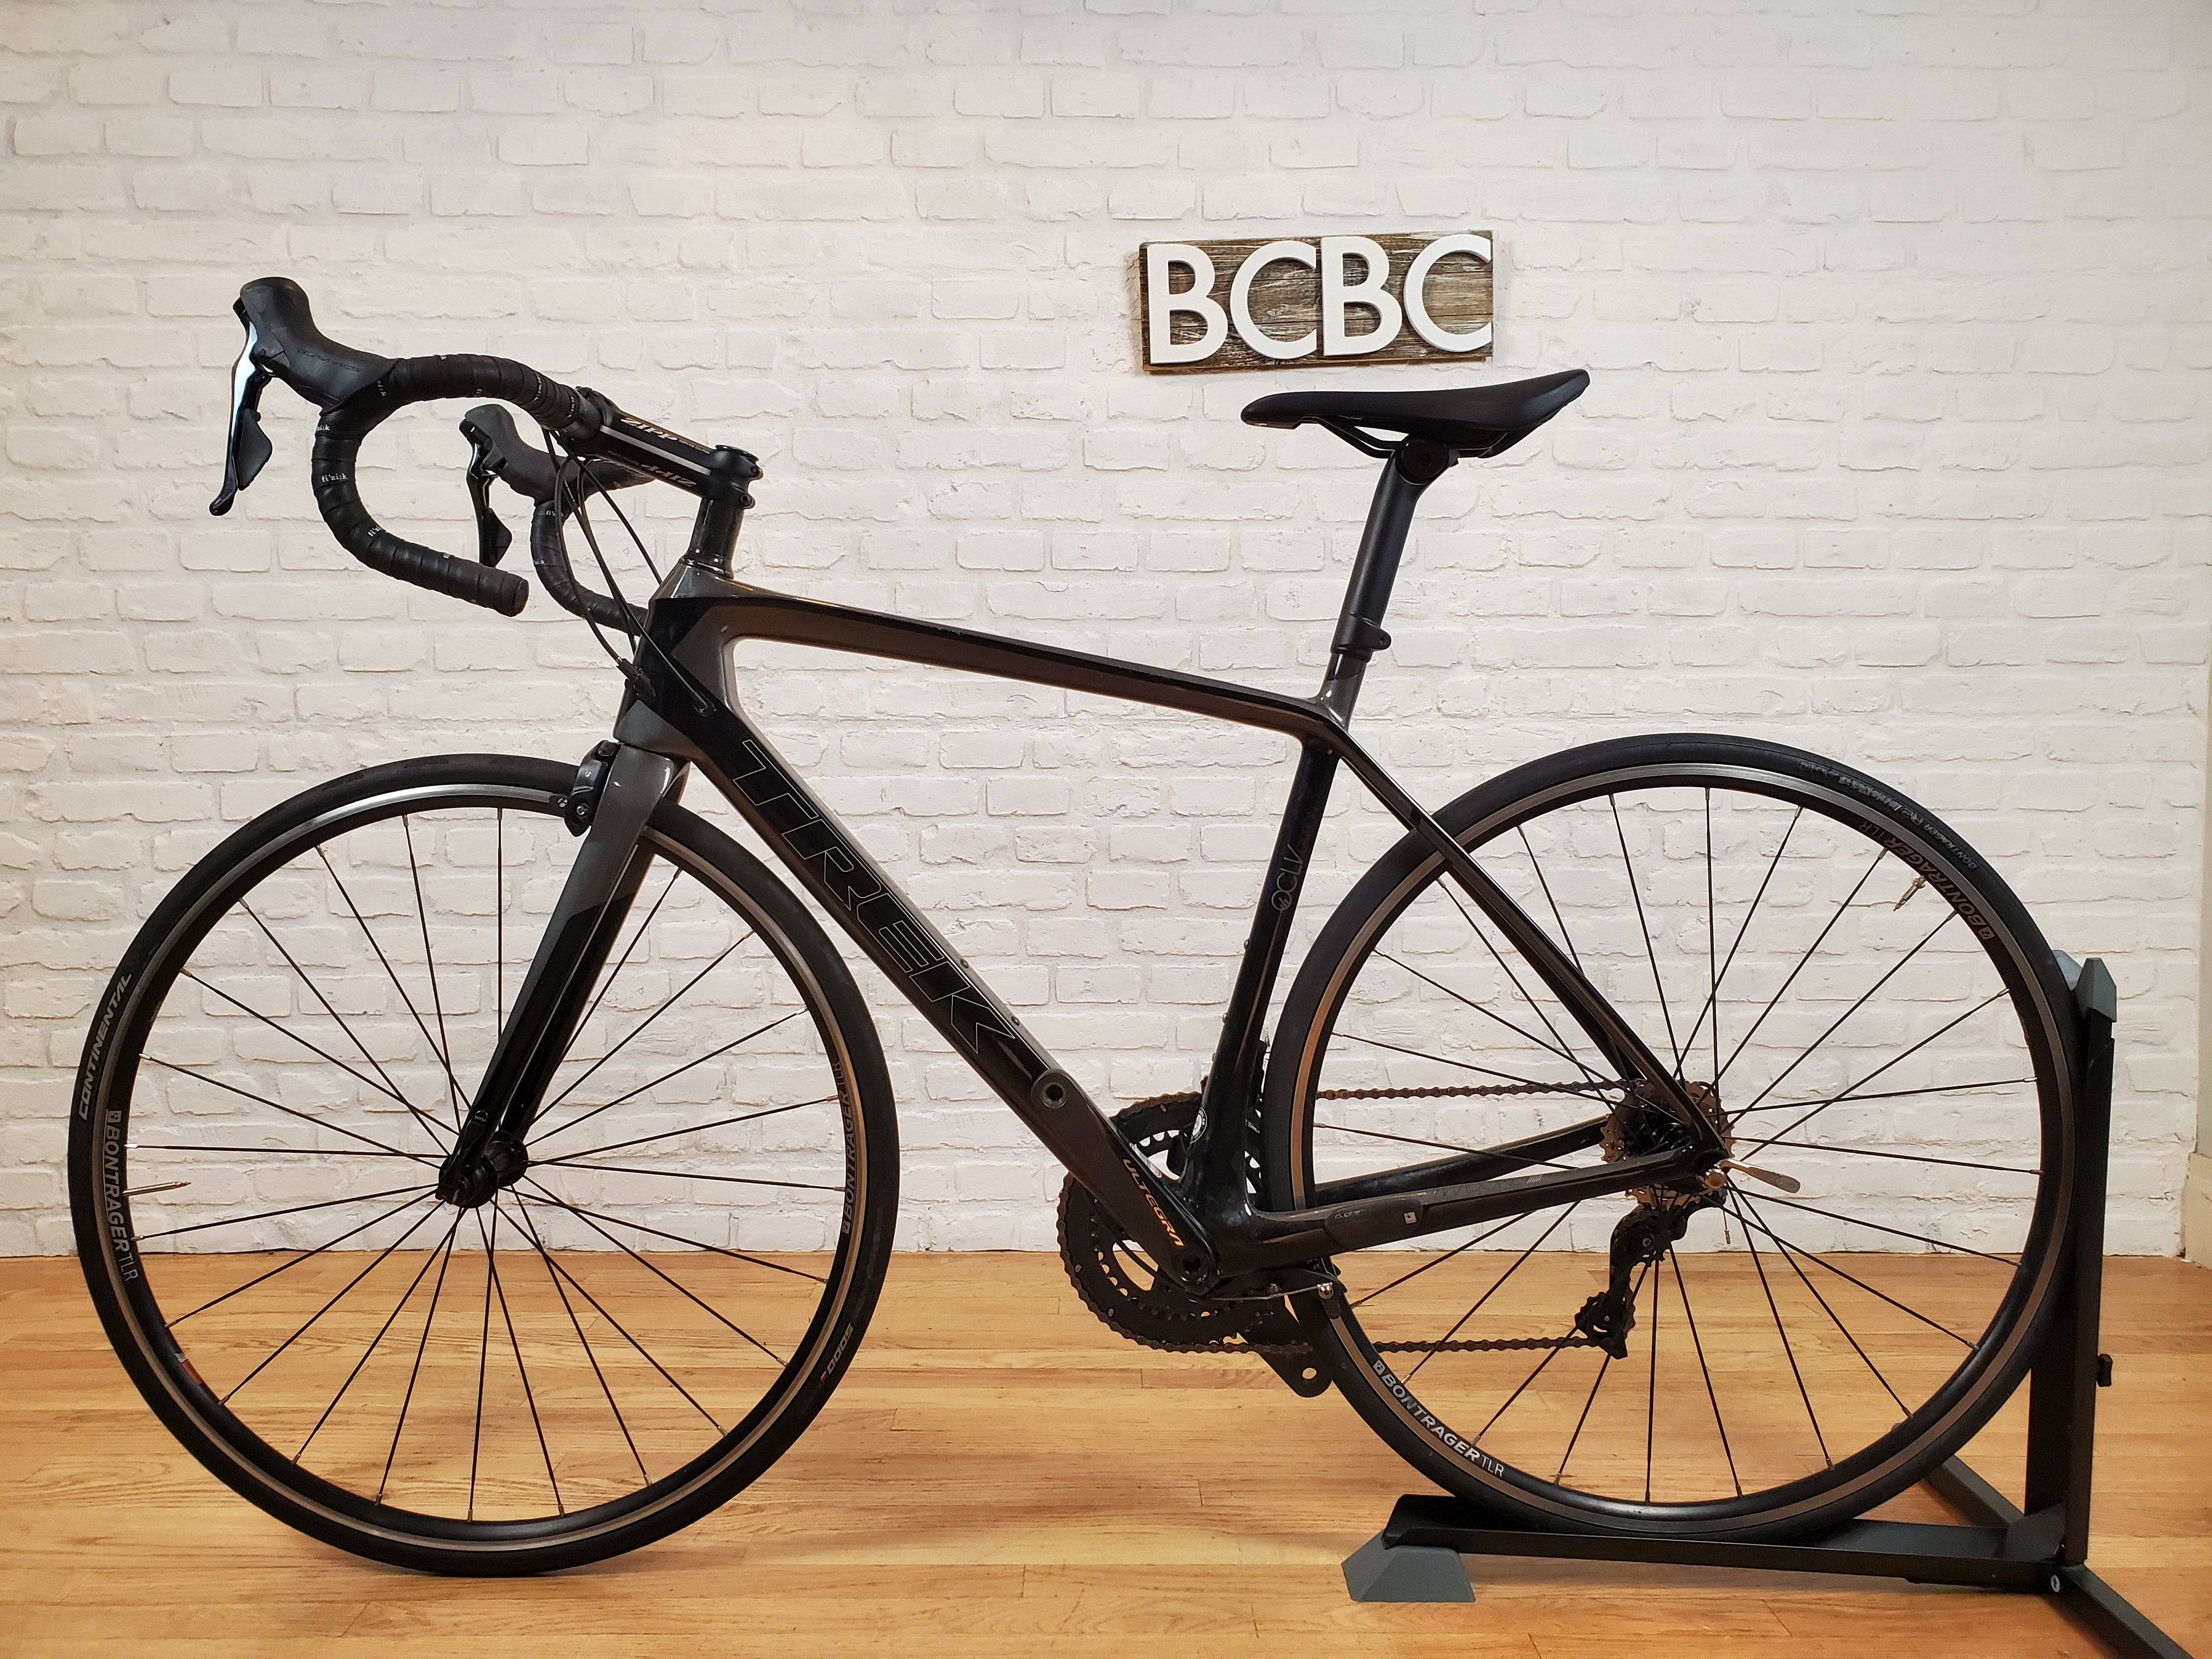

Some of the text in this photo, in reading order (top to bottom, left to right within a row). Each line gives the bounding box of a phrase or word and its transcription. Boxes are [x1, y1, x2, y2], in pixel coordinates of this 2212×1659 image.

[1147, 234, 1491, 364] BCBC
[620, 417, 678, 441] ZIPP
[733, 739, 1015, 1054] TREK
[1883, 837, 1987, 927] BONTRAGER
[78, 973, 132, 1120] CONTINENTAL
[104, 1125, 139, 1282] BONTRAGER TLR
[839, 1090, 857, 1220] BONTRAGER
[1123, 1159, 1184, 1246] ULTEGRA
[1381, 1373, 1504, 1477] BONTRAGER TLR
